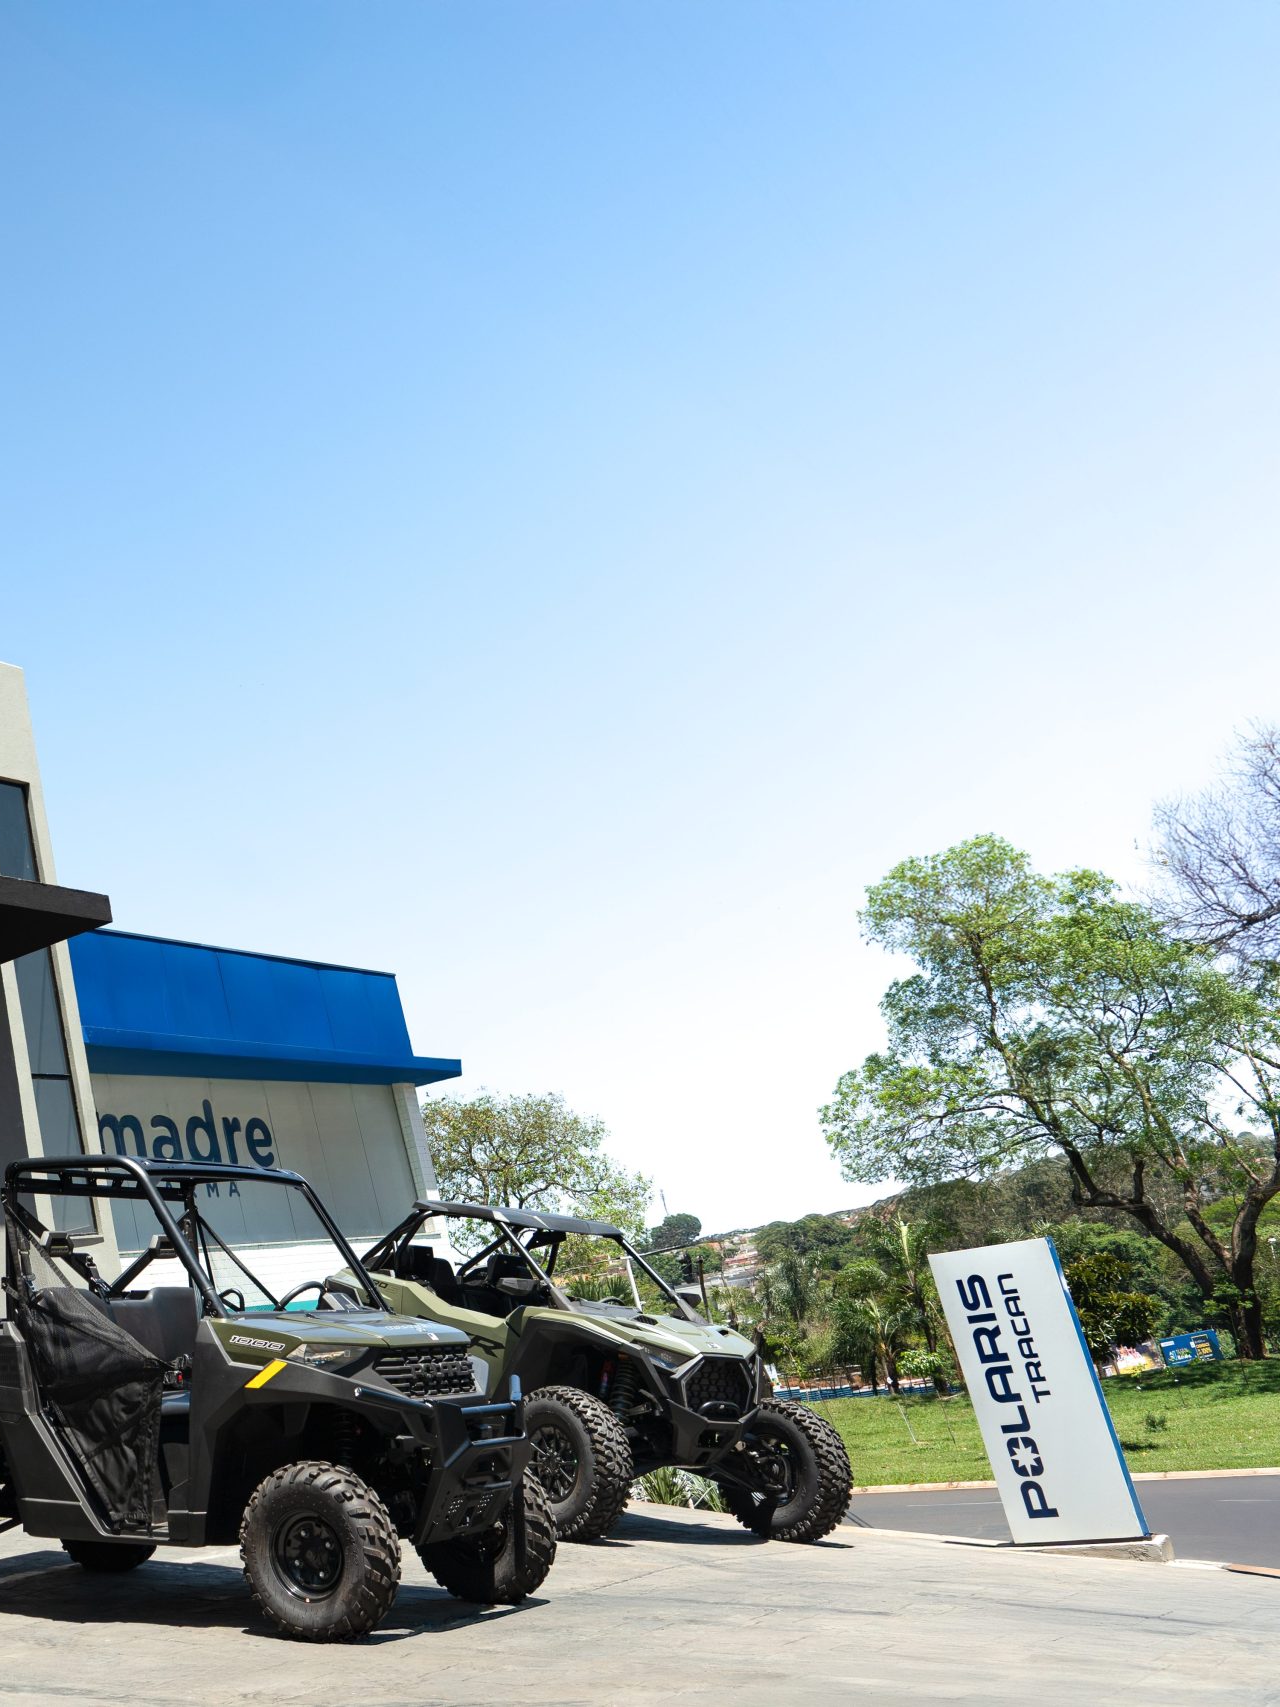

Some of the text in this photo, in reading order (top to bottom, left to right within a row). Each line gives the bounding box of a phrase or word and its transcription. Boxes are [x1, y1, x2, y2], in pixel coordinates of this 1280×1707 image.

[98, 1099, 275, 1167] madre
[229, 1334, 286, 1351] 1000
[997, 1273, 1051, 1403] TRACAN
[956, 1274, 1059, 1519] POLARIS
